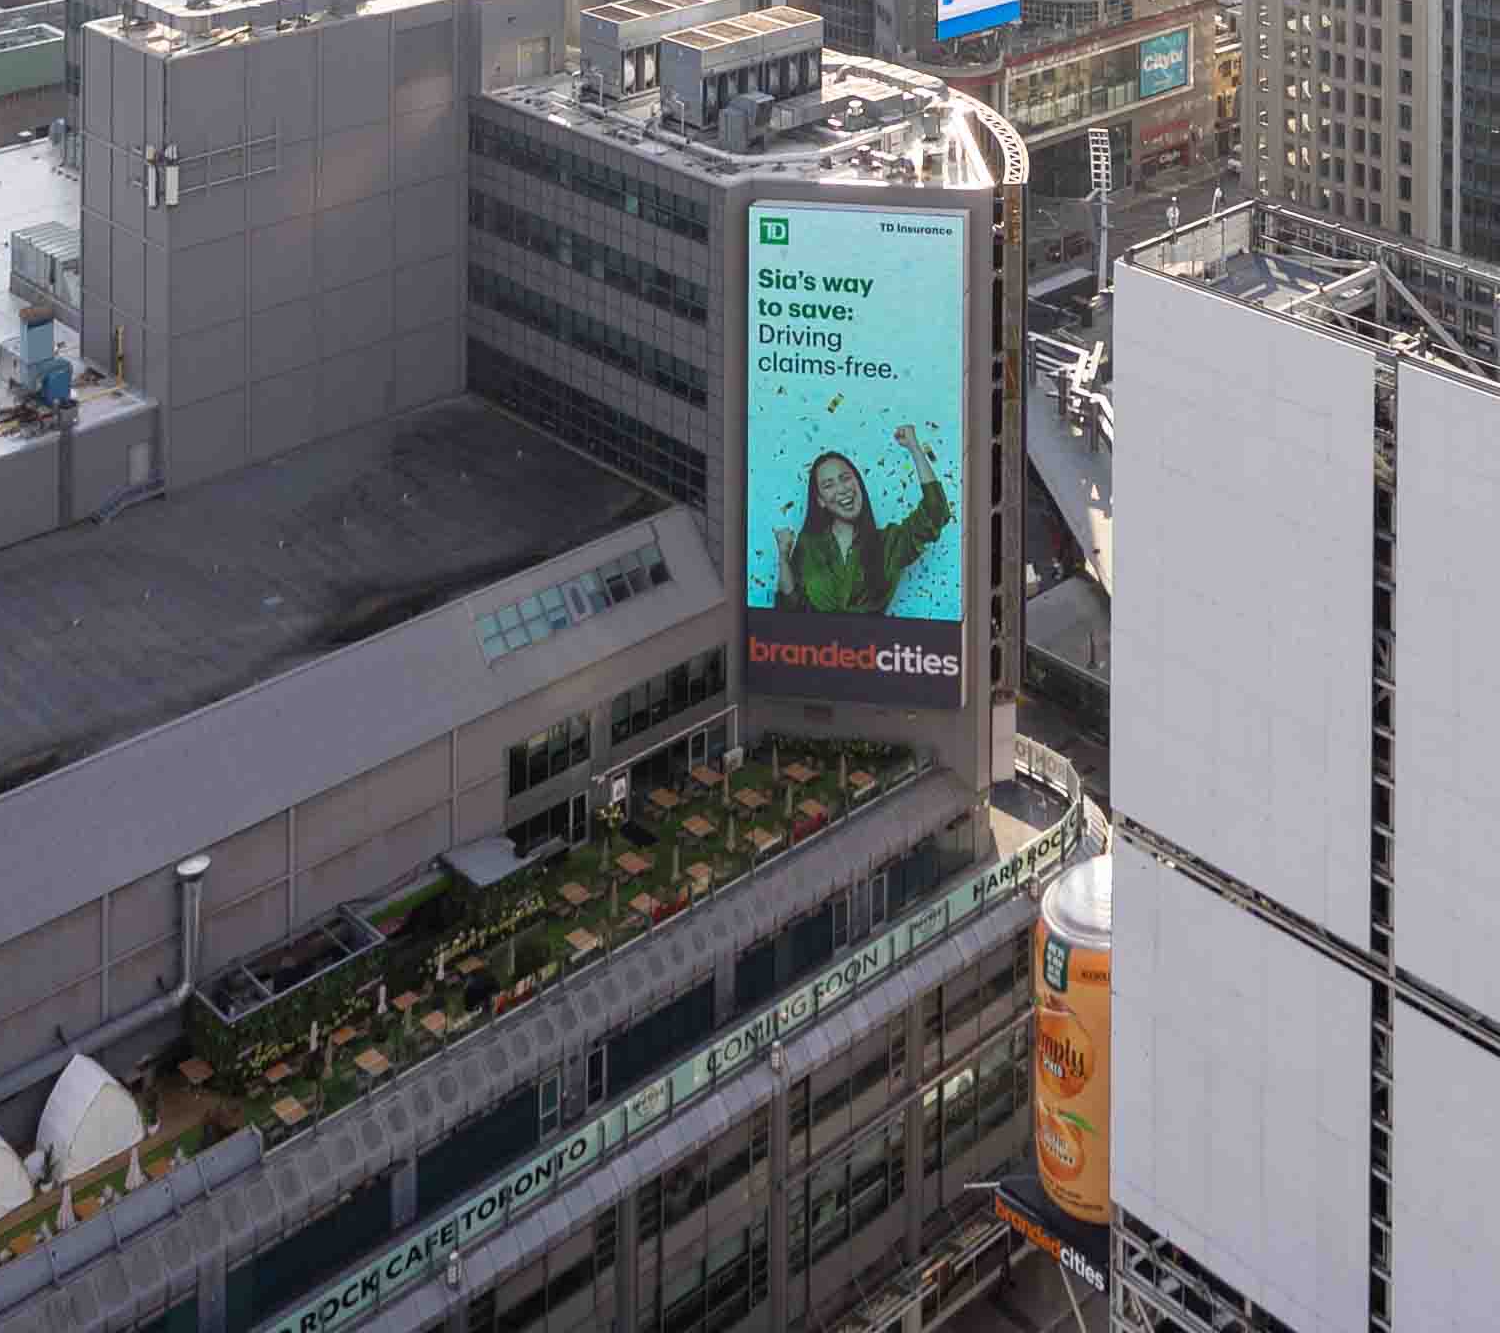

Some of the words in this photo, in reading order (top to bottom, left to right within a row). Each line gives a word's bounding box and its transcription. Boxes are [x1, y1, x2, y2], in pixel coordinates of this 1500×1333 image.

[762, 221, 787, 241] TD
[880, 221, 895, 233] TD
[897, 223, 953, 236] Insurance
[758, 268, 817, 292] Sia's
[822, 277, 875, 298] way
[758, 298, 783, 318] to
[788, 303, 854, 321] save:
[758, 324, 843, 353] Driving
[758, 351, 900, 381] claims-free.
[749, 637, 960, 677] brandedcities
[973, 857, 1024, 902] HARD
[707, 994, 807, 1072] COMING
[301, 1270, 380, 1333] ROCK
[385, 1221, 454, 1280] CAFE
[462, 1136, 589, 1231] TORONTO
